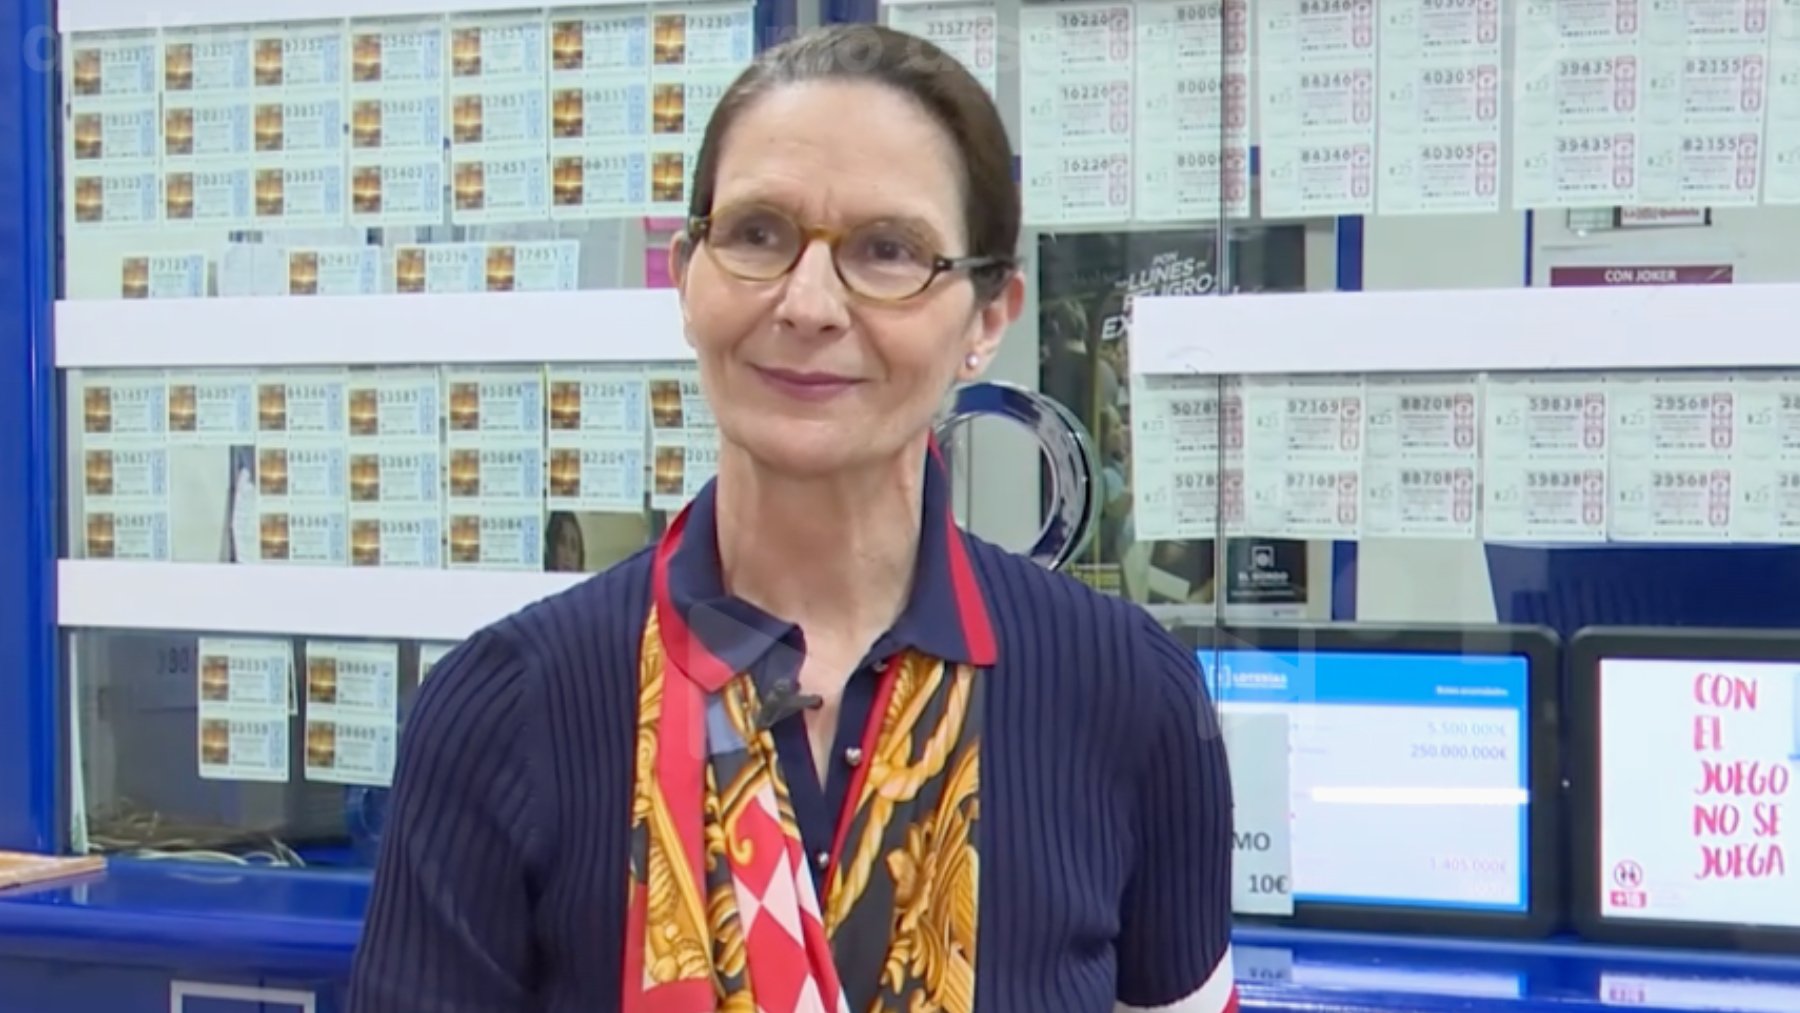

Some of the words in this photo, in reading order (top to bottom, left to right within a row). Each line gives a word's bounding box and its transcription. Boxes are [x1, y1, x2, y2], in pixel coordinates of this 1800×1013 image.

[1126, 257, 1194, 292] LUNES
[1604, 269, 1633, 283] CON
[1635, 269, 1678, 283] JOKER
[1694, 671, 1758, 711] CON
[1693, 714, 1724, 752] EL
[1693, 760, 1789, 797] JUEGO
[1693, 803, 1740, 837] NO
[1752, 801, 1784, 838] SE
[1693, 843, 1785, 881] JUEGA
[1248, 873, 1289, 895] 10€
